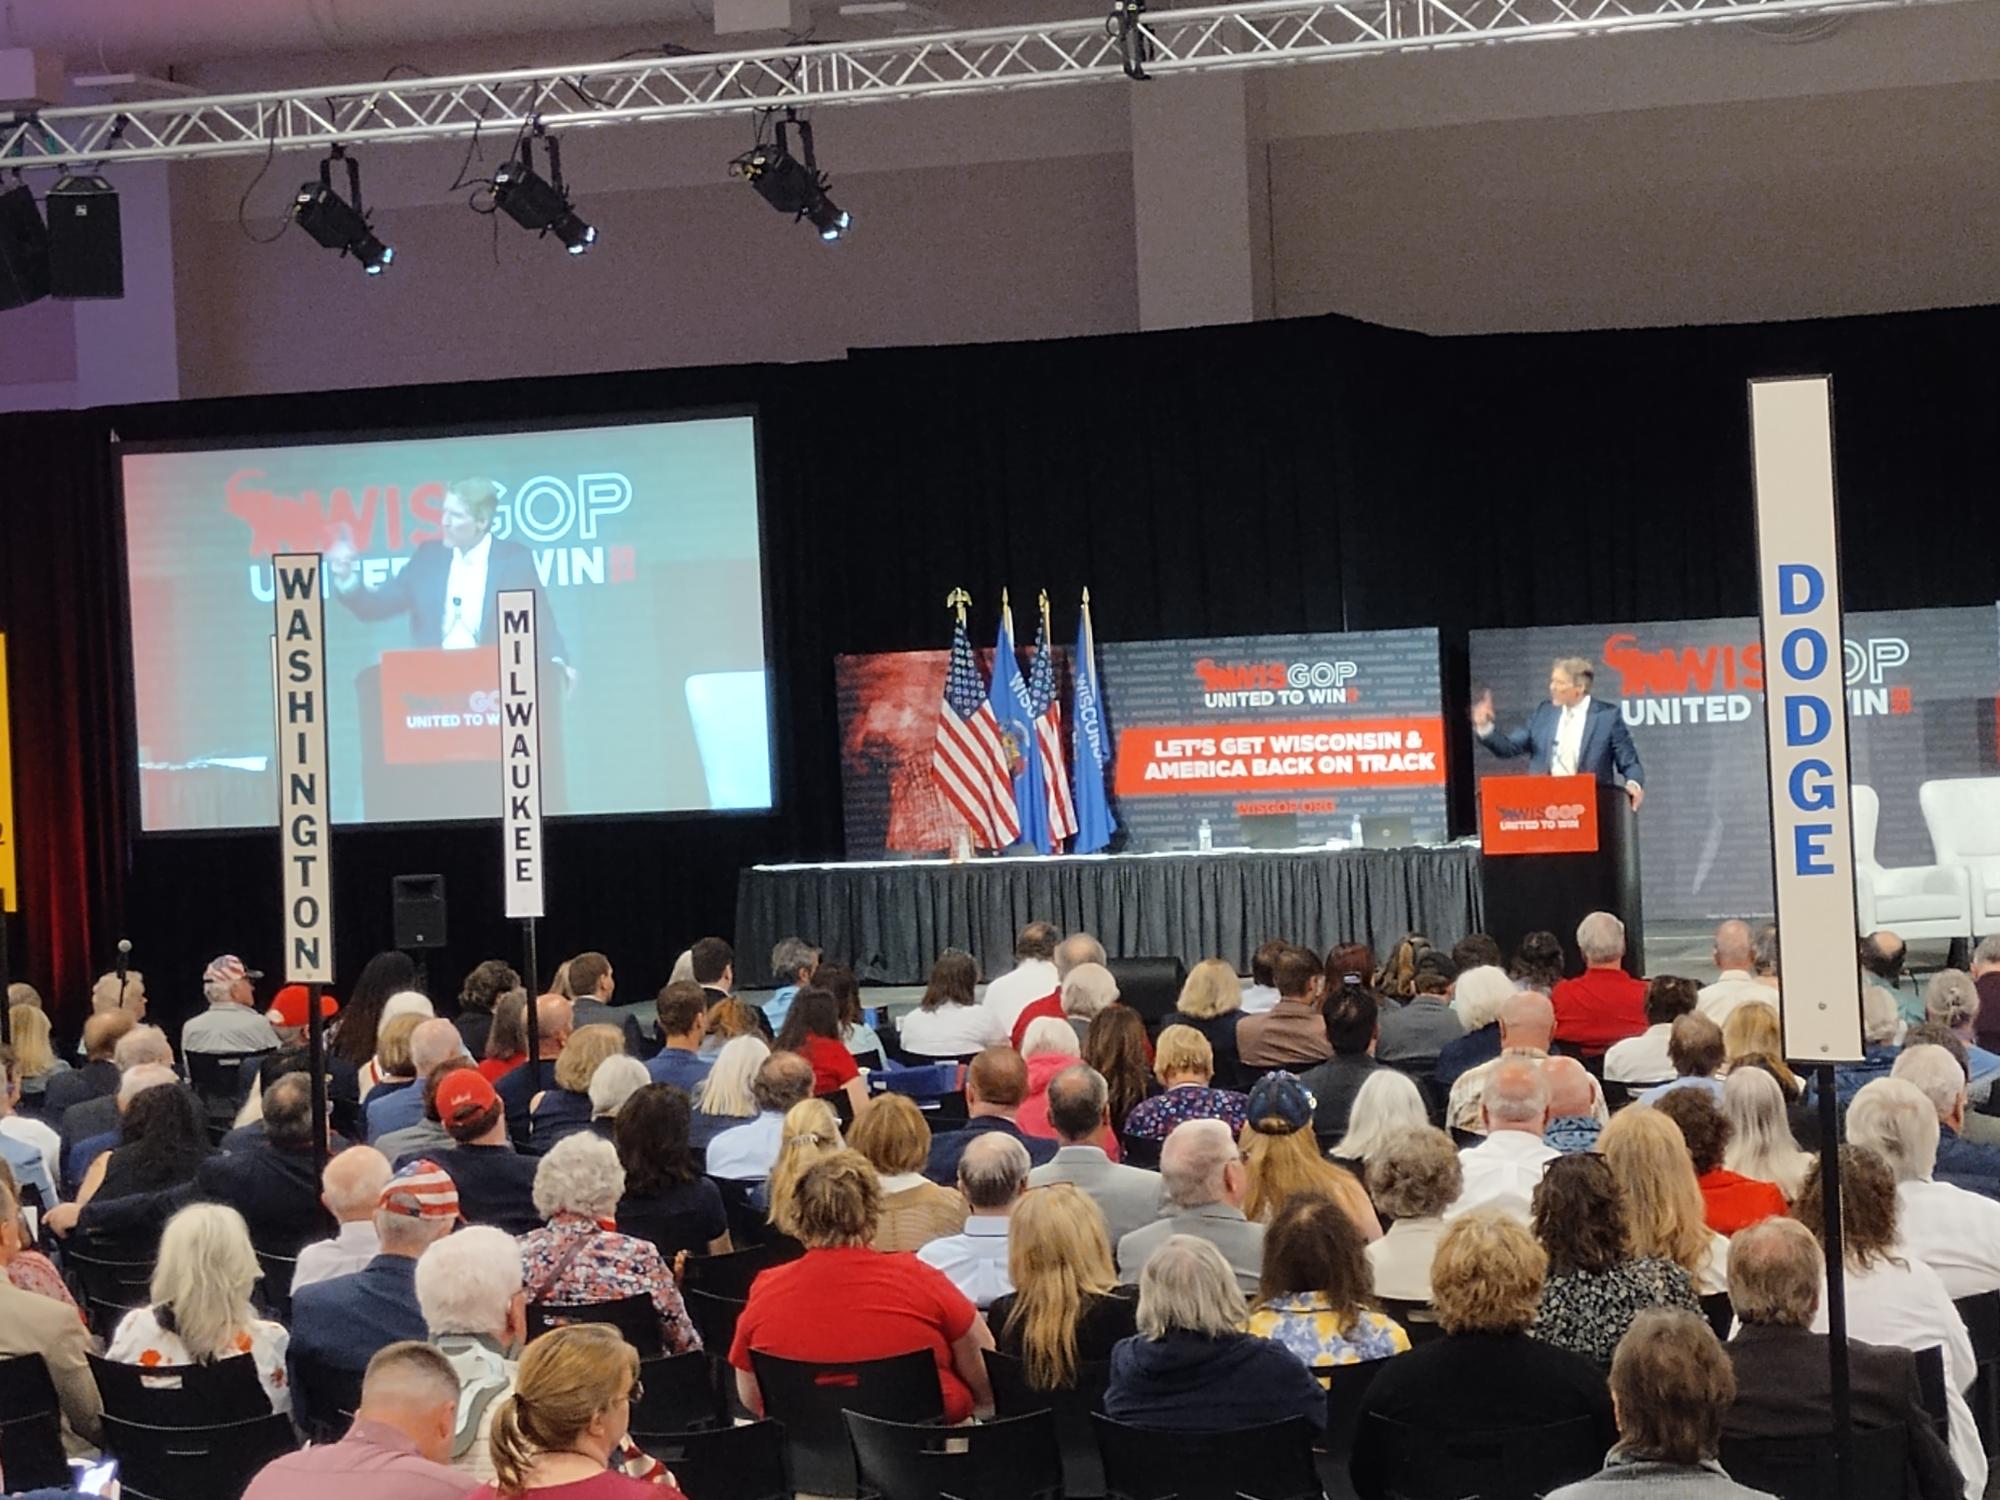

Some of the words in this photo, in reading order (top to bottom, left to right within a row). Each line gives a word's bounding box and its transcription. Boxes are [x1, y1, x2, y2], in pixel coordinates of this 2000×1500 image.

[1204, 691, 1275, 708] UNITED
[1277, 690, 1305, 705] TO
[1307, 687, 1347, 704] WIN
[1622, 695, 1751, 726] UNITED
[406, 714, 460, 728] UNITED
[464, 714, 482, 726] TO
[1778, 563, 1836, 877] DODGE
[504, 610, 533, 882] MILWAUKEE
[1154, 737, 1216, 758] LET'S
[1220, 736, 1265, 756] GET
[1269, 731, 1401, 753] WISCONSIN
[1405, 731, 1422, 748] &
[278, 567, 320, 970] WASHINGTON
[1144, 758, 1248, 780] AMERICA
[1252, 755, 1314, 776] BACK
[1317, 754, 1351, 774] ON
[1357, 752, 1436, 772] TRACK
